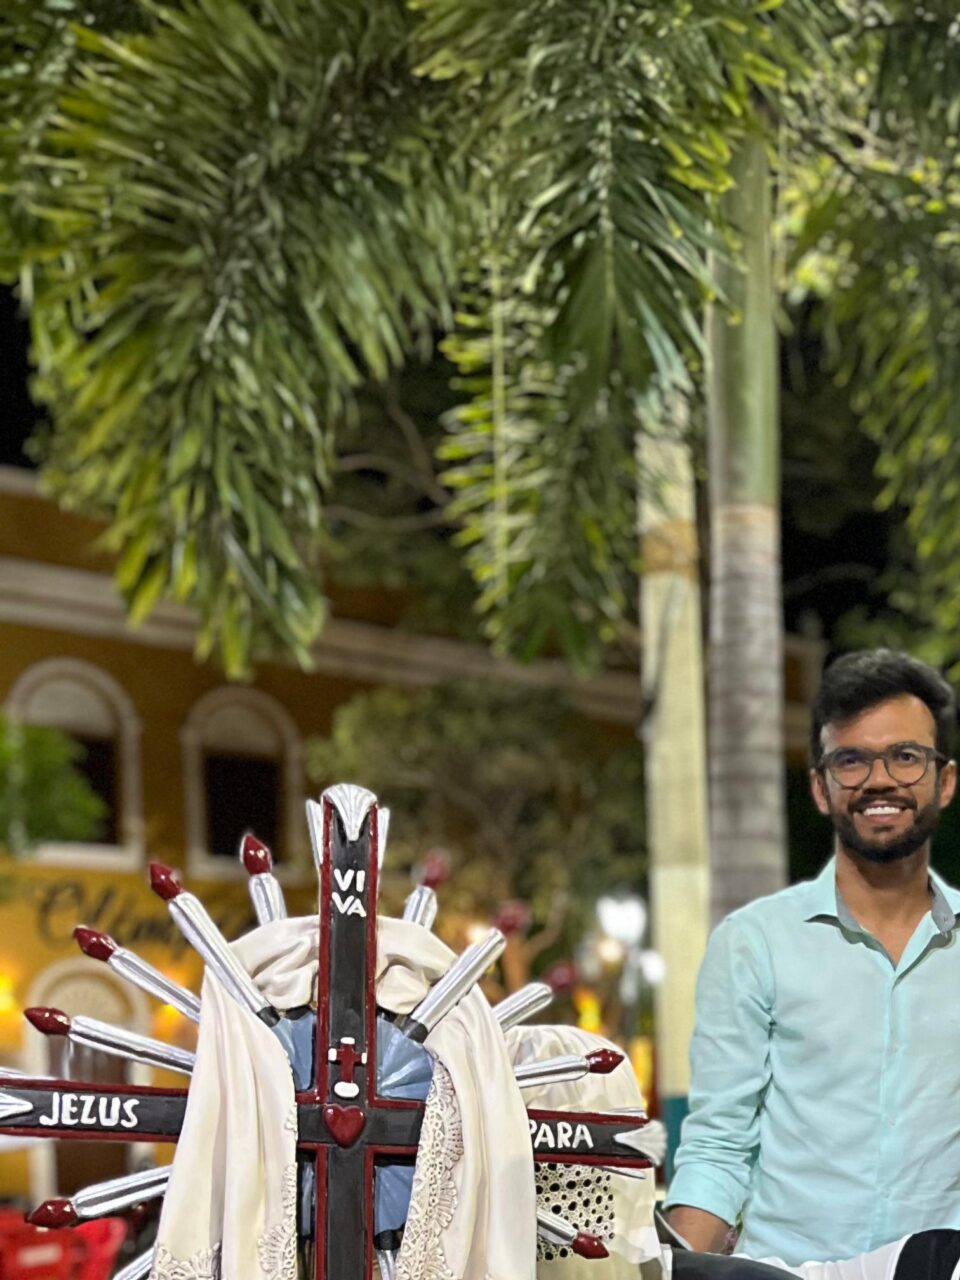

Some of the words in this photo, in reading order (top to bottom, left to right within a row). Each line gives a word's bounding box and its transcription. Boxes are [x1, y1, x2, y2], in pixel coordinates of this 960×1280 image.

[333, 868, 365, 892] VI
[331, 891, 367, 918] VA
[39, 1091, 140, 1128] JEZUS
[529, 1119, 594, 1149] PARA
